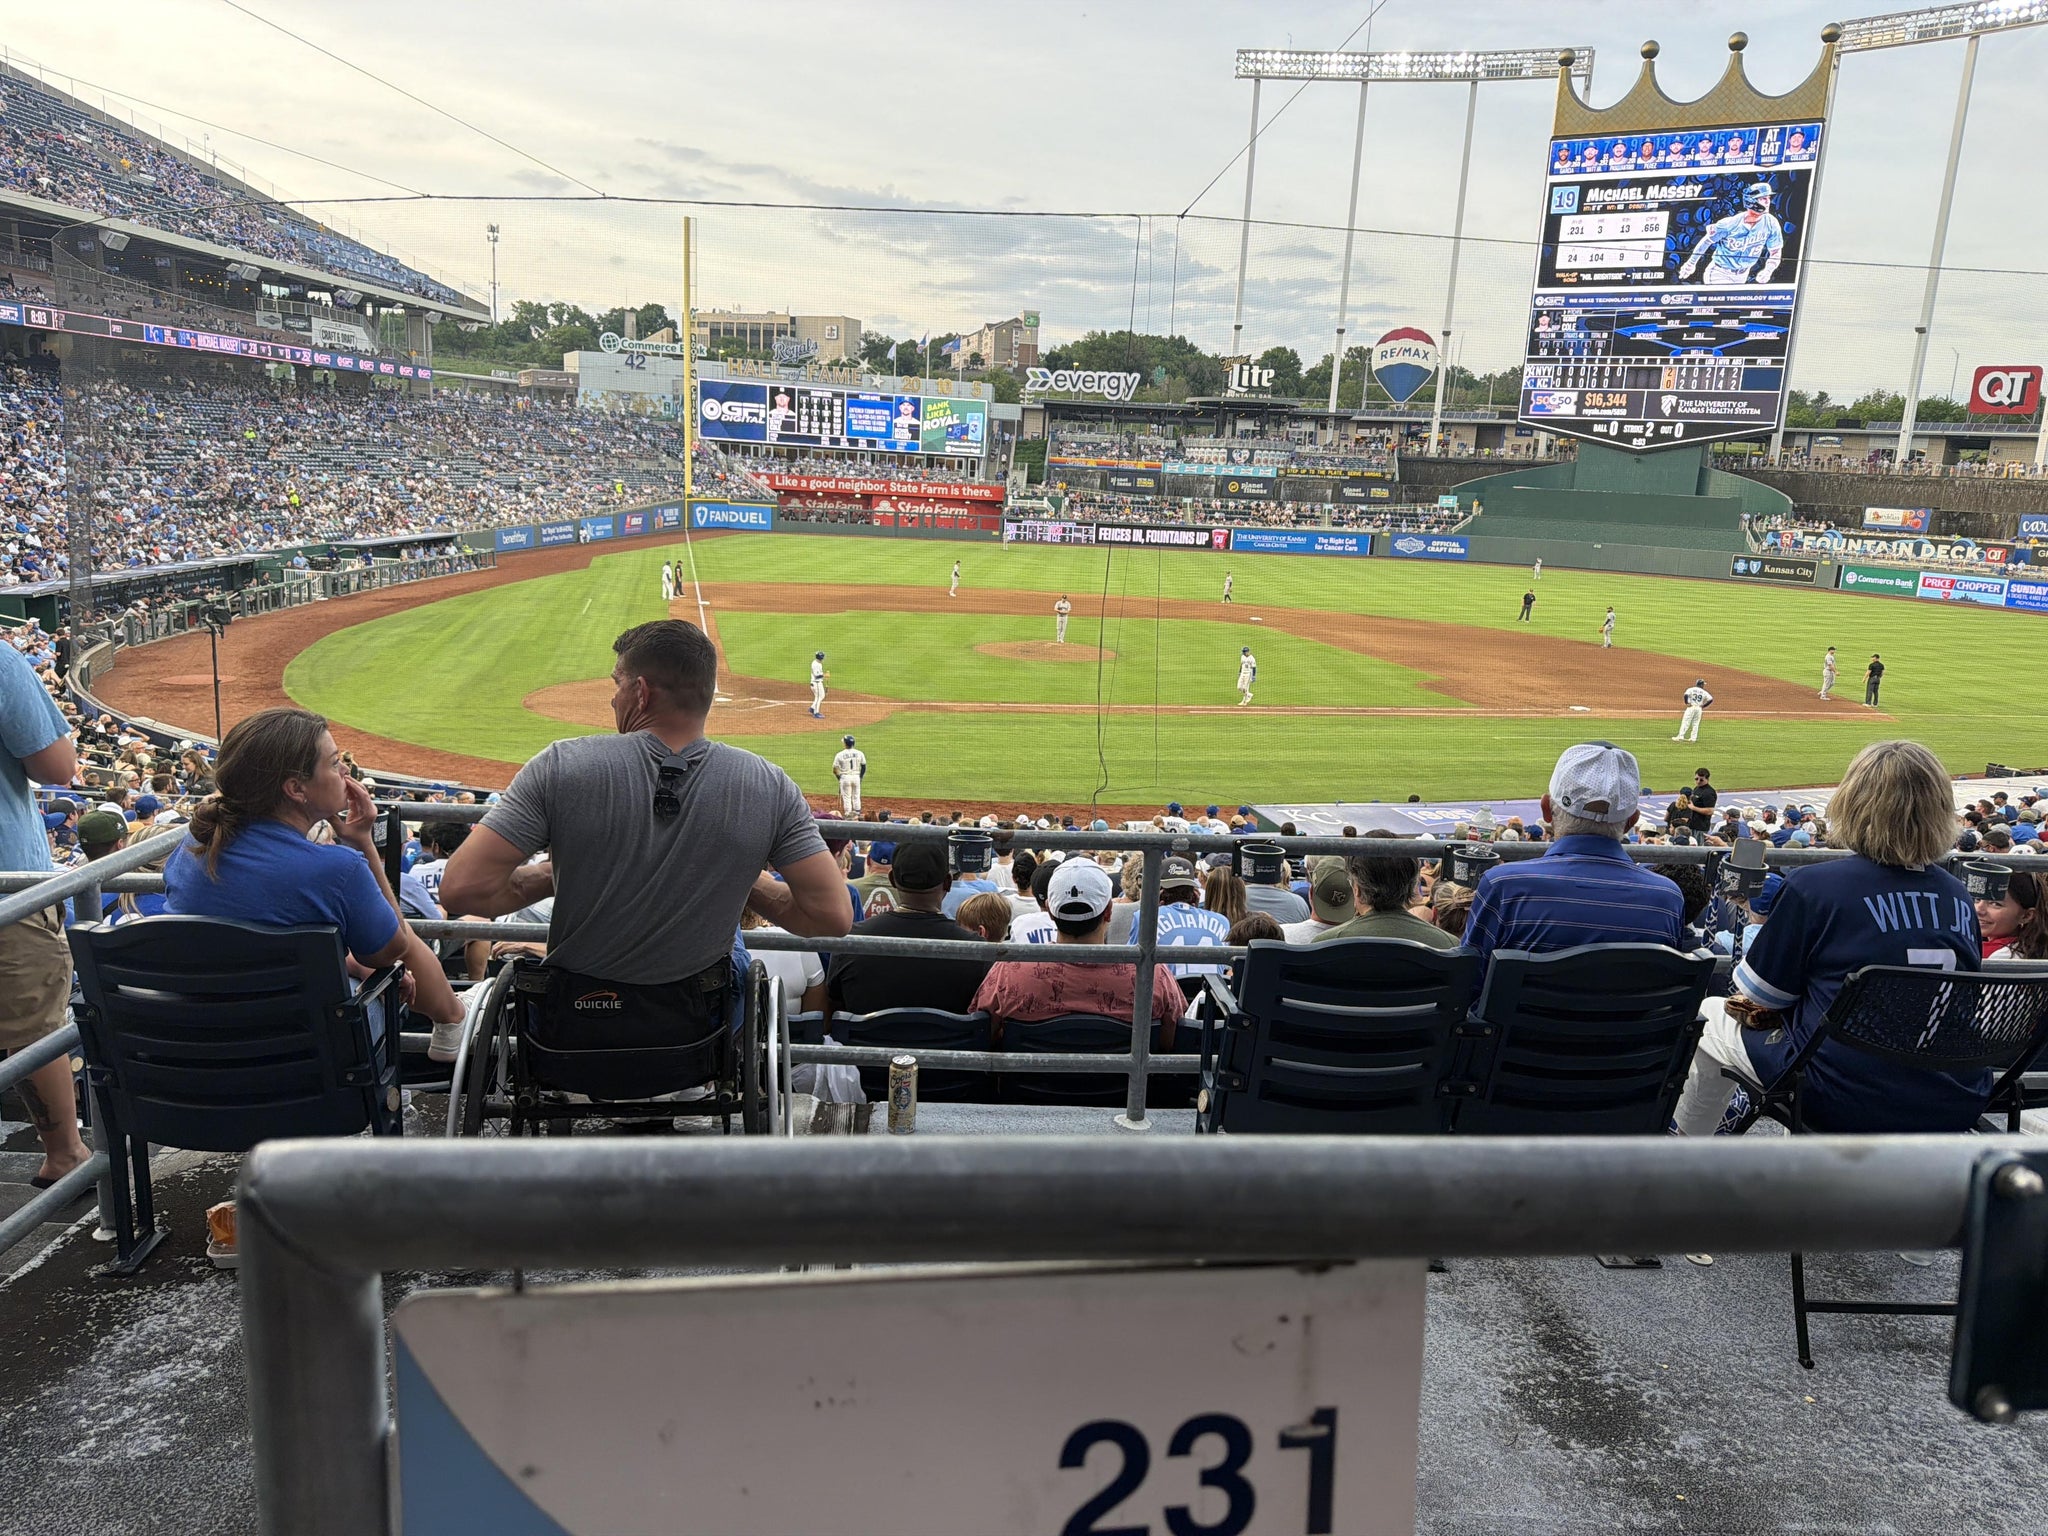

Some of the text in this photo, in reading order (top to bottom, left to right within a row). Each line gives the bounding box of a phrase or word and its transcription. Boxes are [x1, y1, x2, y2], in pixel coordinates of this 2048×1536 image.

[1766, 129, 1780, 141] AT
[1761, 142, 1780, 155] BAT
[1555, 191, 1576, 208] 19
[1586, 184, 1702, 202] MICHAEL MASSEY
[1568, 227, 1584, 235] .231
[1598, 226, 1603, 234] 3
[1641, 224, 1659, 232] .656
[1589, 254, 1604, 262] 104
[30, 310, 46, 324] 8:03
[322, 329, 335, 341] CRAFT
[621, 339, 676, 352] Commerce
[772, 337, 819, 364] Royals
[1381, 347, 1430, 361] RE/MAX
[625, 355, 646, 370] 42
[727, 356, 784, 380] HALL
[806, 365, 863, 386] FAME
[1228, 364, 1275, 392] Lite
[1535, 367, 1738, 377] NYY 0 0 0 2 0 0 2 4 0 2 4 2
[902, 376, 920, 392] 20
[936, 378, 952, 394] 10
[972, 380, 982, 397] 5
[1054, 374, 1137, 398] evergy
[1536, 379, 1548, 387] KC
[1979, 370, 2033, 408] QT
[927, 401, 949, 411] BANK
[1536, 396, 1549, 404] 50
[1585, 392, 1627, 407] $16,344
[721, 415, 765, 424] DIGITAL
[926, 411, 944, 419] LIKE
[923, 414, 960, 431] ROYAL
[1593, 421, 1684, 438] BALL 0 STRIKE 2 OUT 0
[776, 476, 798, 487] Like
[810, 477, 835, 491] good
[838, 478, 887, 493] neighbor,
[890, 482, 918, 494] State
[921, 484, 948, 495] Farm
[951, 485, 959, 495] is
[962, 486, 993, 498] there.
[710, 510, 766, 524] FANDUEL
[502, 532, 528, 545] benefitbay
[1099, 527, 1210, 545] FENCES IN, FOUNTAINS UP
[1803, 534, 1982, 560] FOUNTAIN DECK
[1988, 550, 2003, 561] QT
[1764, 564, 1814, 578] Kansas City
[1858, 575, 1893, 585] Commerce
[1925, 578, 2000, 593] PRICE CHOPPER
[850, 760, 854, 770] 1
[872, 904, 890, 913] Fort
[1864, 892, 1974, 942] WITT JR.
[1027, 928, 1057, 944] WIT
[574, 1000, 623, 1010] QUICKIE
[890, 1072, 911, 1088] Coors
[1058, 1405, 1338, 1536] 231
